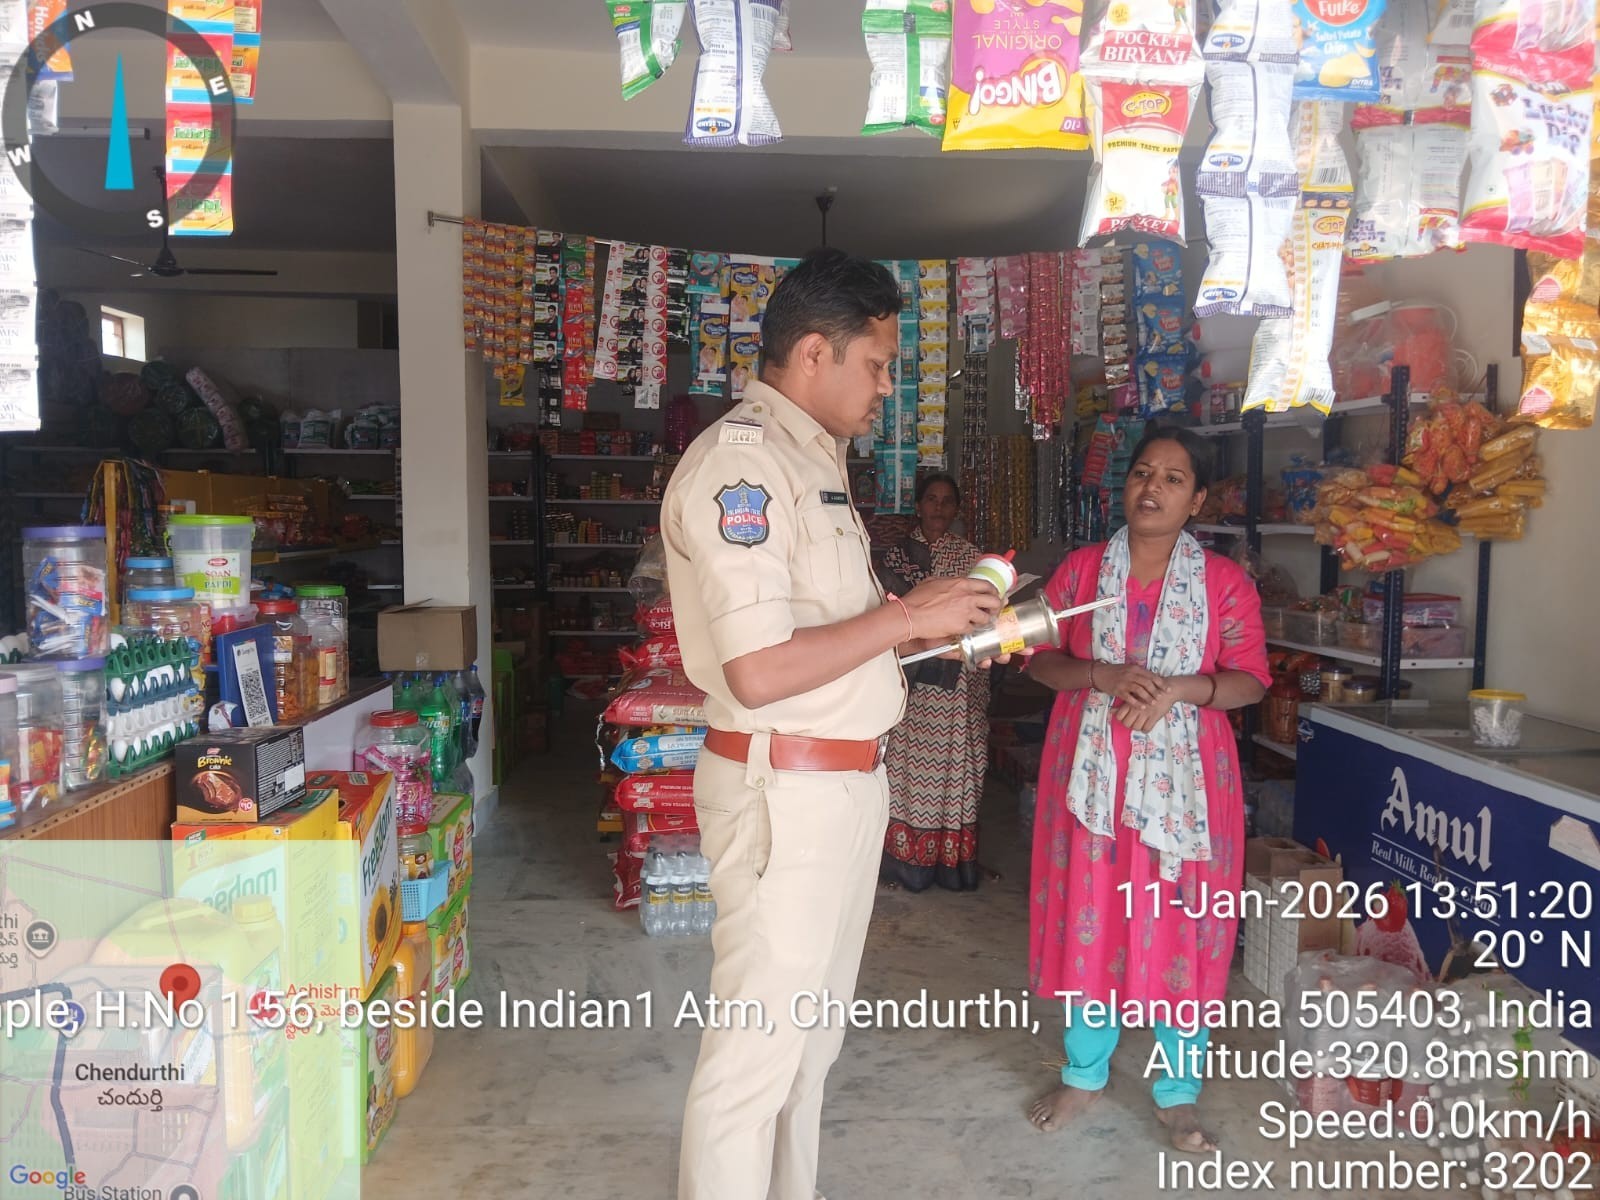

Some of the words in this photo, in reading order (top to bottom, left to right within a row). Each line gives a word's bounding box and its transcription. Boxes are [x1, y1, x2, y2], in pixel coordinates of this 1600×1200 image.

[993, 19, 1040, 30] STYLE
[971, 34, 1062, 50] ORIGINAL
[1114, 31, 1183, 49] POCKET
[1103, 46, 1187, 65] BIRYANI
[1107, 140, 1137, 149] PREMIUM
[1110, 217, 1172, 232] POKET
[726, 514, 763, 526] POLICE
[197, 755, 233, 768] Brownie
[1380, 766, 1493, 872] Amul
[361, 796, 394, 897] Freedom
[1371, 840, 1392, 862] Real
[1393, 850, 1418, 876] Milk.
